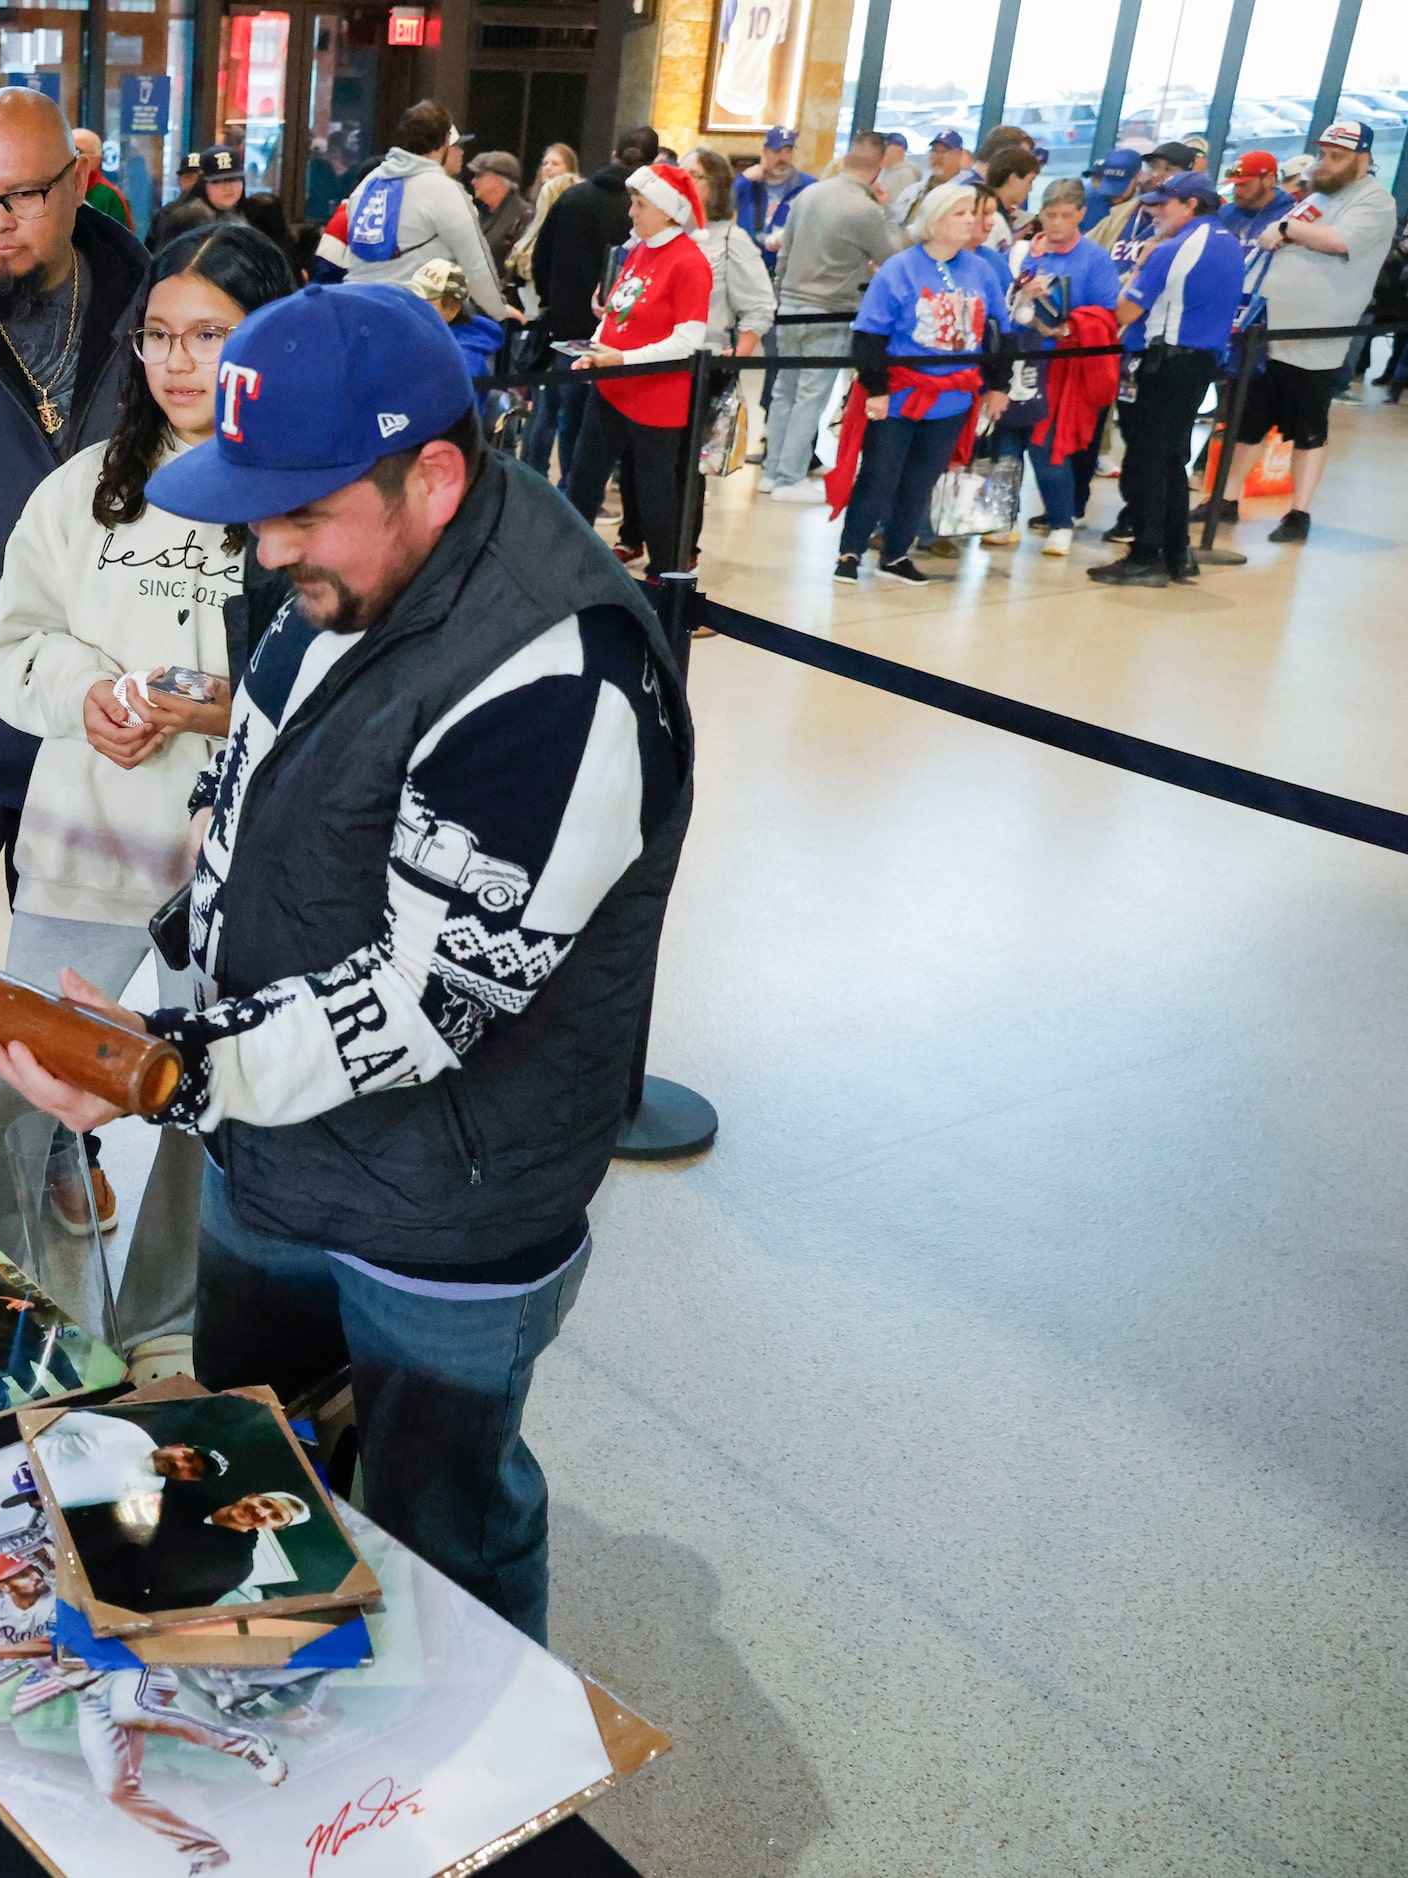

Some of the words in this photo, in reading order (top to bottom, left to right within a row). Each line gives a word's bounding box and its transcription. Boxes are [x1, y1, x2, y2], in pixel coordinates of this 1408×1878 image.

[395, 19, 419, 42] EXIT
[748, 6, 771, 40] 10
[219, 361, 262, 443] T
[138, 578, 187, 598] SINCE
